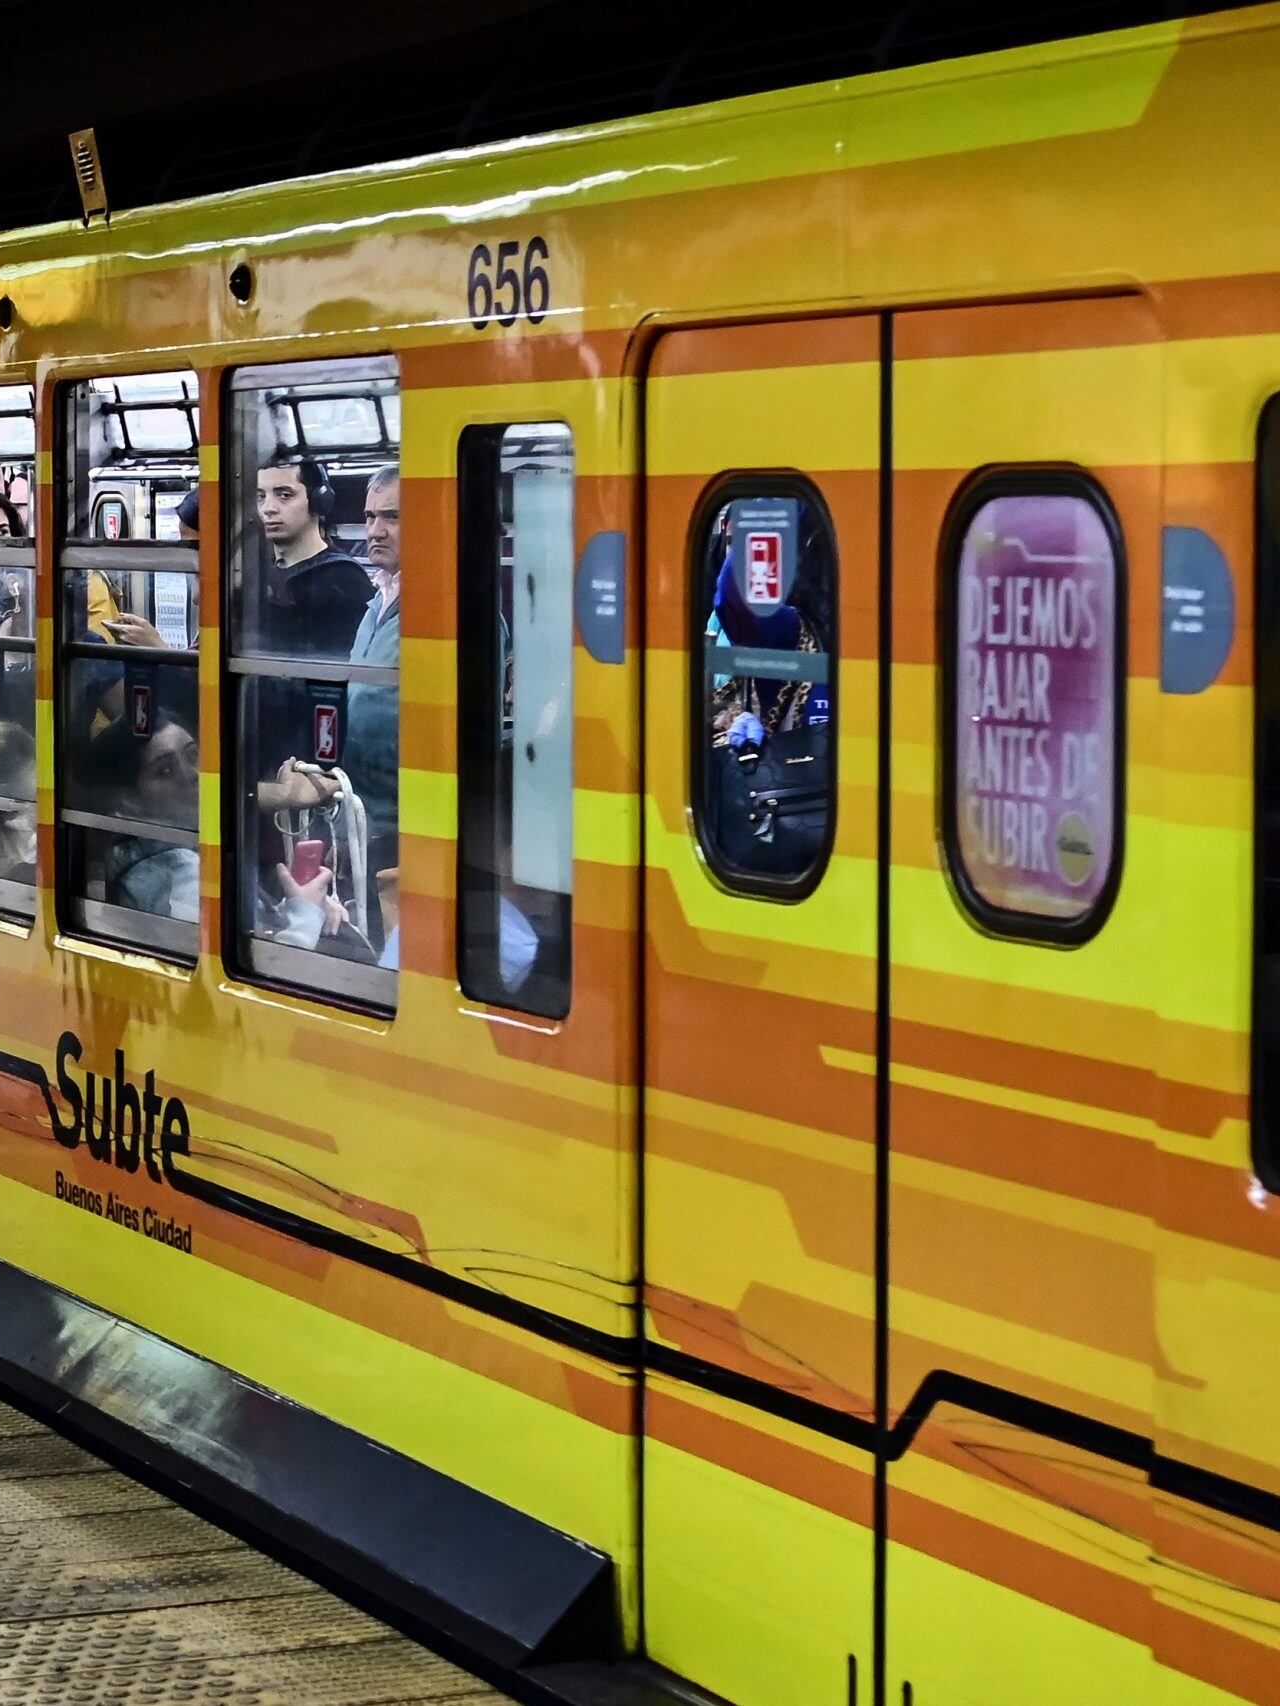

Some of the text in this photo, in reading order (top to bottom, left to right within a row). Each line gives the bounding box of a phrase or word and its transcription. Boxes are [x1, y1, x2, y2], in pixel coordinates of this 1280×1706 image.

[468, 236, 549, 330] 656
[966, 575, 1097, 648] DEJEMOS
[966, 650, 1052, 724] BAJAR
[966, 724, 1099, 801] ANTES DE
[52, 1031, 191, 1187] Subte
[55, 1170, 193, 1255] Buenos Aires Ciudad
